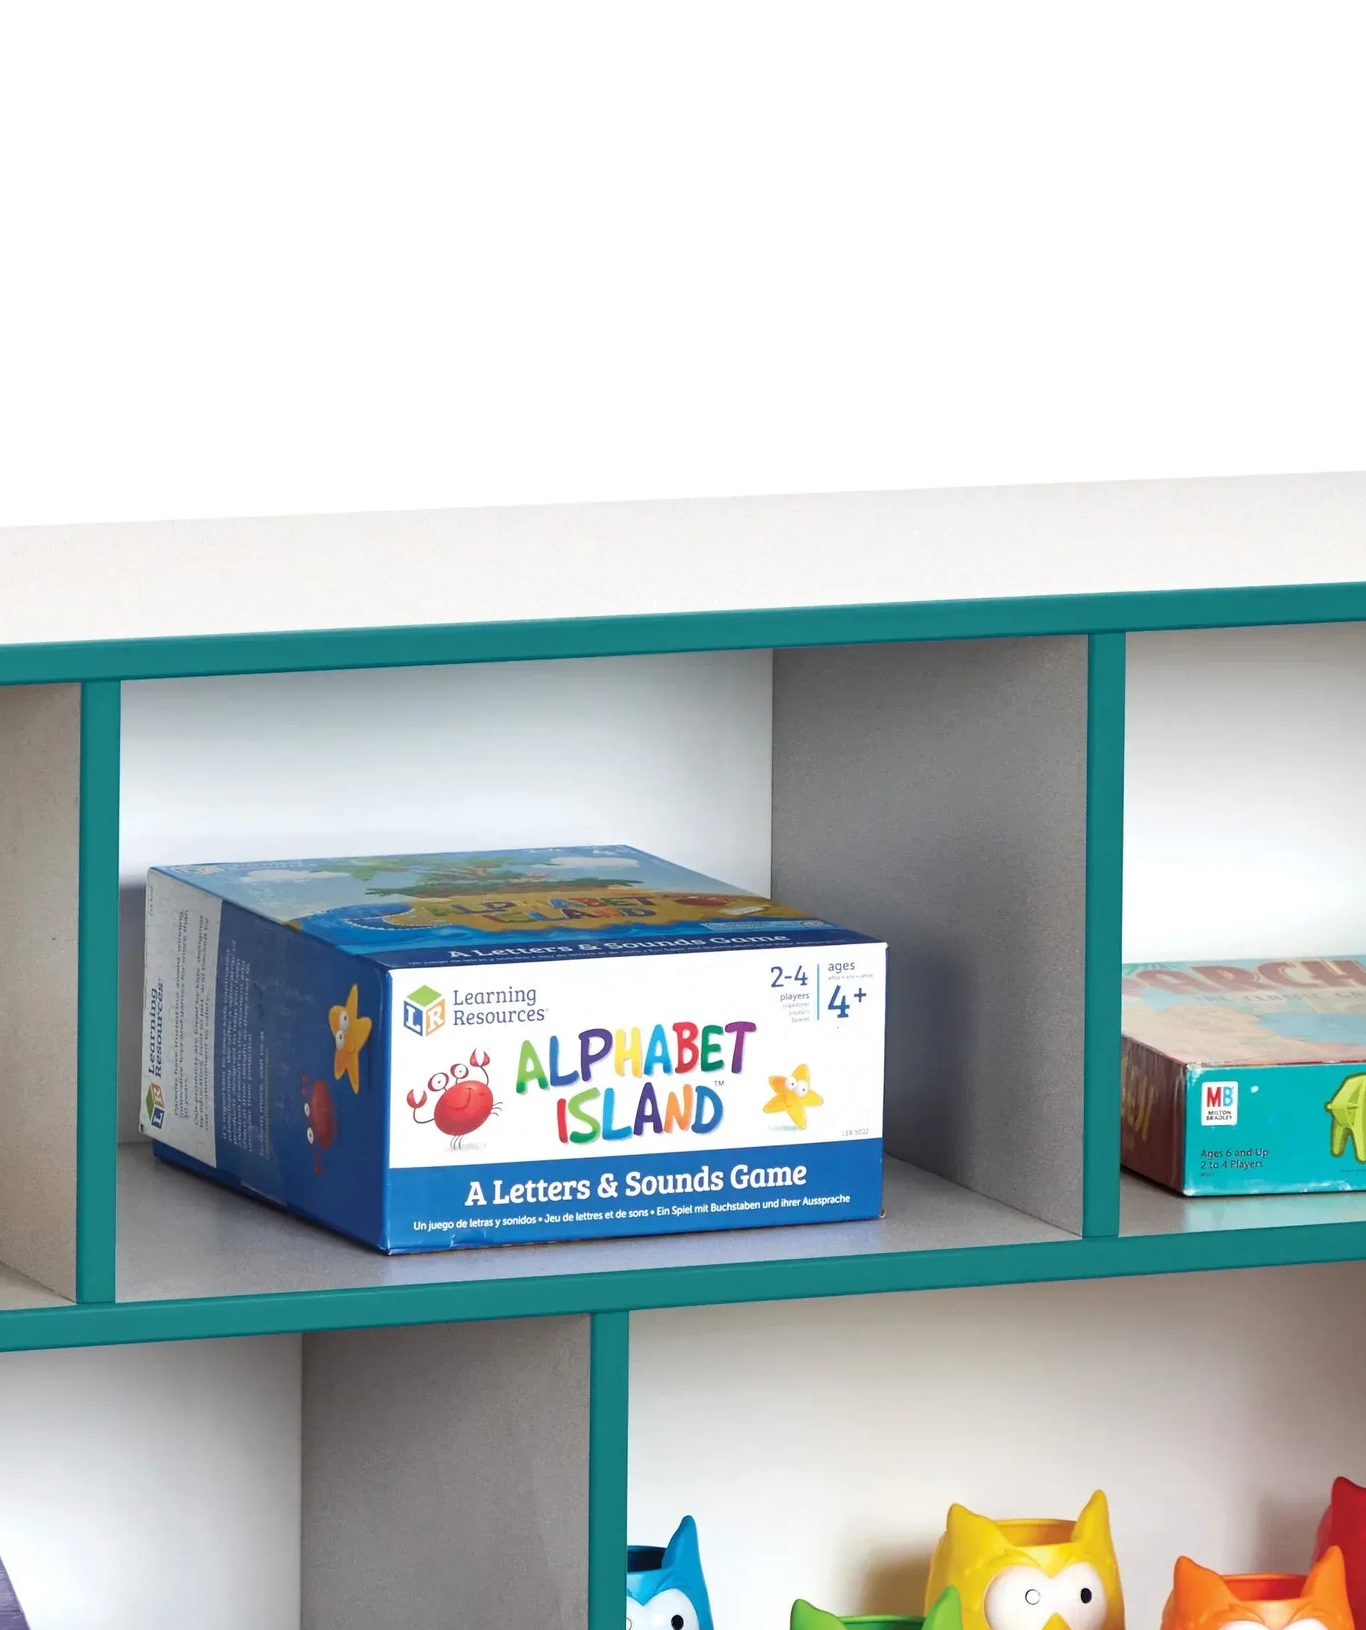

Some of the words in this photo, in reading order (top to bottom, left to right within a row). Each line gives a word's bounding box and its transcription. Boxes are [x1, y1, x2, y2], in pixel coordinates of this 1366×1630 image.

[474, 946, 573, 956] Letters
[604, 939, 706, 949] Sounds
[709, 936, 790, 944] Game
[770, 965, 808, 987] 2-4
[828, 961, 855, 973] ages
[453, 987, 537, 1006] Learning
[780, 992, 810, 1002] players
[827, 985, 867, 1018] 4+
[453, 1008, 545, 1026] Resources
[148, 987, 157, 1076] Learning
[155, 982, 164, 1079] Resources
[516, 1021, 757, 1094] ALPHABET
[1206, 1086, 1234, 1108] MB
[557, 1082, 725, 1144] ISLAND
[1201, 1149, 1223, 1158] Ages
[1225, 1149, 1232, 1157] 6
[1234, 1148, 1252, 1157] and
[1255, 1148, 1269, 1158] Up
[1200, 1161, 1207, 1169] 2
[1209, 1160, 1219, 1169] to
[1221, 1160, 1228, 1168] 4
[1231, 1160, 1264, 1170] Players
[464, 1181, 487, 1206] A
[492, 1178, 591, 1205] Letters
[597, 1173, 618, 1199] &
[625, 1165, 724, 1197] Sounds
[730, 1164, 807, 1190] Game
[413, 1221, 427, 1231] Un
[427, 1218, 454, 1232] juego
[456, 1218, 468, 1229] de
[469, 1217, 494, 1228] letras
[494, 1219, 501, 1228] y
[502, 1214, 537, 1226] sonidos
[544, 1213, 561, 1223] Jeu
[562, 1212, 575, 1222] de
[575, 1211, 603, 1222] lettres
[604, 1211, 614, 1220] et
[615, 1209, 627, 1219] de
[628, 1208, 649, 1218] sons
[656, 1206, 670, 1216] Ein
[671, 1204, 693, 1217] Spiel
[694, 1203, 709, 1214] mit
[710, 1200, 761, 1212] Buchstaben
[762, 1198, 779, 1209] und
[781, 1197, 800, 1208] ihrer
[802, 1193, 851, 1208] Aussprache
